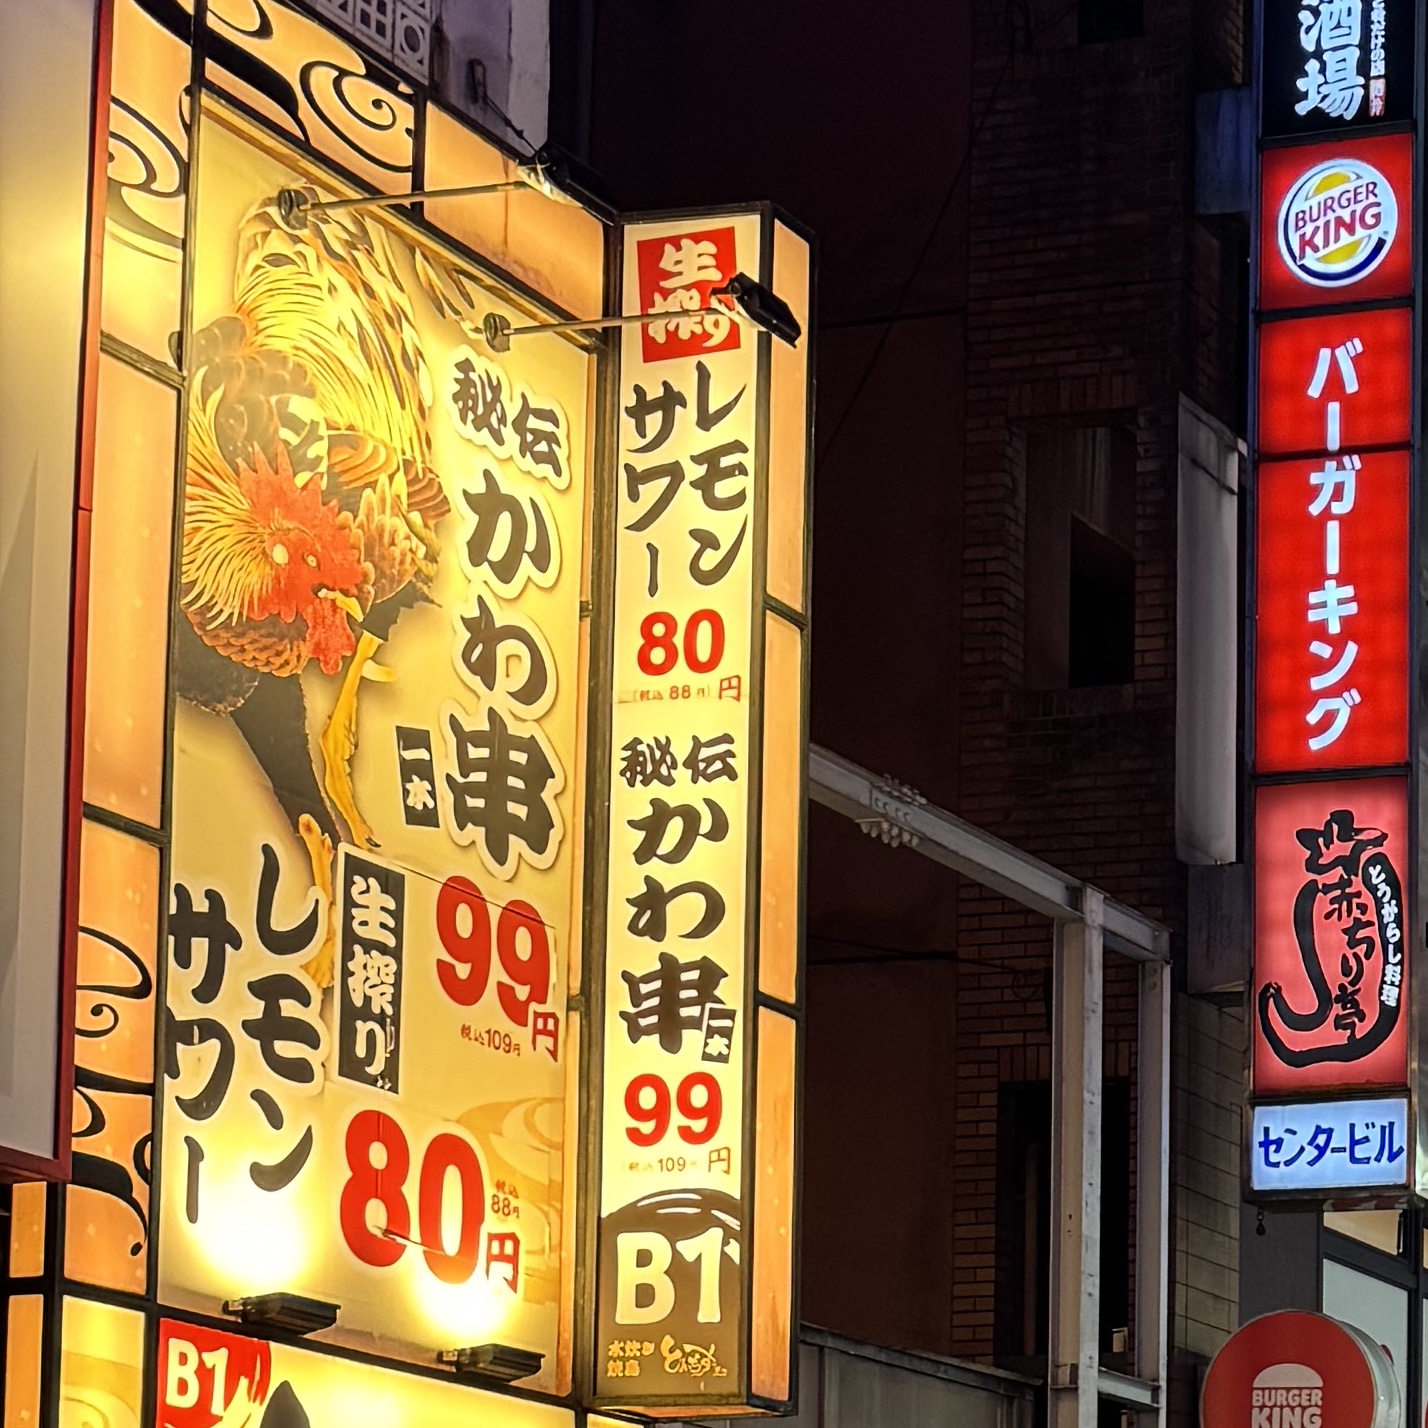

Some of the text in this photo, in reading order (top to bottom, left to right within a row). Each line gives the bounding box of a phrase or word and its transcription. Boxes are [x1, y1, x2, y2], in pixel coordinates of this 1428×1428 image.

[1294, 0, 1365, 119] 酒場
[1294, 181, 1379, 233] BURGER
[1298, 202, 1383, 262] KING
[451, 356, 564, 478] 秘伝
[689, 362, 750, 584] レモン
[624, 381, 688, 598] サワー
[1307, 337, 1362, 751] バーガーキング
[446, 468, 557, 868] かわ串
[637, 609, 742, 703] 80 円
[620, 733, 739, 788] 秘伝
[435, 875, 560, 1062] 99 円
[620, 796, 730, 1056] かわ串
[165, 883, 244, 1226] サワー
[242, 843, 322, 1193] レモン
[624, 1072, 732, 1174] 99 円
[1258, 1120, 1405, 1169] センタービル
[340, 1109, 520, 1294] 80 円
[616, 1231, 740, 1325] B1
[166, 1341, 229, 1417] B1
[1252, 1389, 1323, 1407] BURGER
